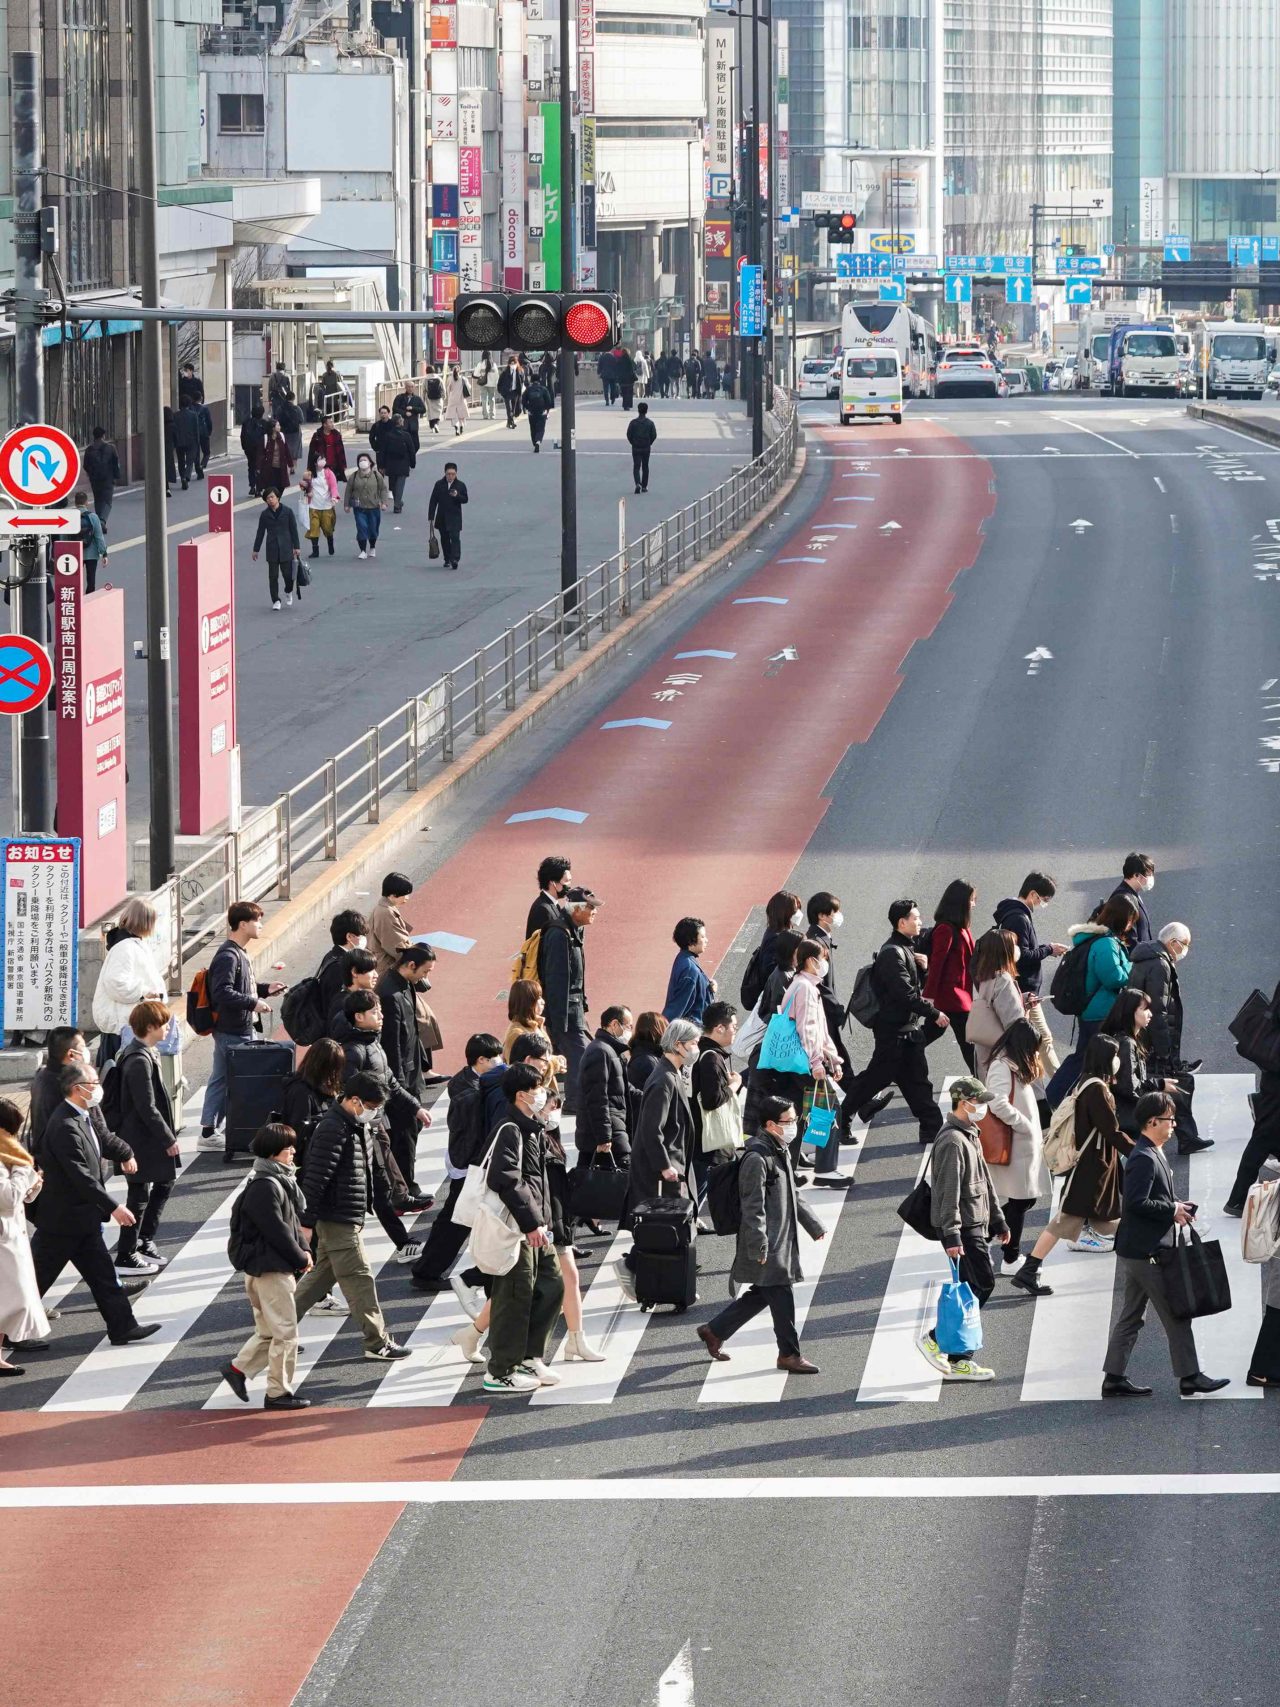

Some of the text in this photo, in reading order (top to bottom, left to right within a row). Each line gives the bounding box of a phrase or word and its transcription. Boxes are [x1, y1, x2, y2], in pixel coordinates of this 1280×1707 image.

[460, 150, 472, 193] Serina
[717, 180, 728, 193] P
[545, 183, 558, 223] レイク
[462, 235, 477, 243] 2F
[508, 209, 518, 259] docomo
[531, 227, 541, 235] 3F
[949, 257, 977, 267] 日本橋
[1004, 257, 1025, 267] 四谷
[61, 586, 76, 719] 新宿駅南口周辺案内
[8, 847, 72, 860] お知らせ
[30, 864, 40, 990] タクシー乗降場をご利用願います。
[7, 949, 15, 990] 新宿警察署
[15, 921, 25, 1022] 国土交通省 東京国道事務所
